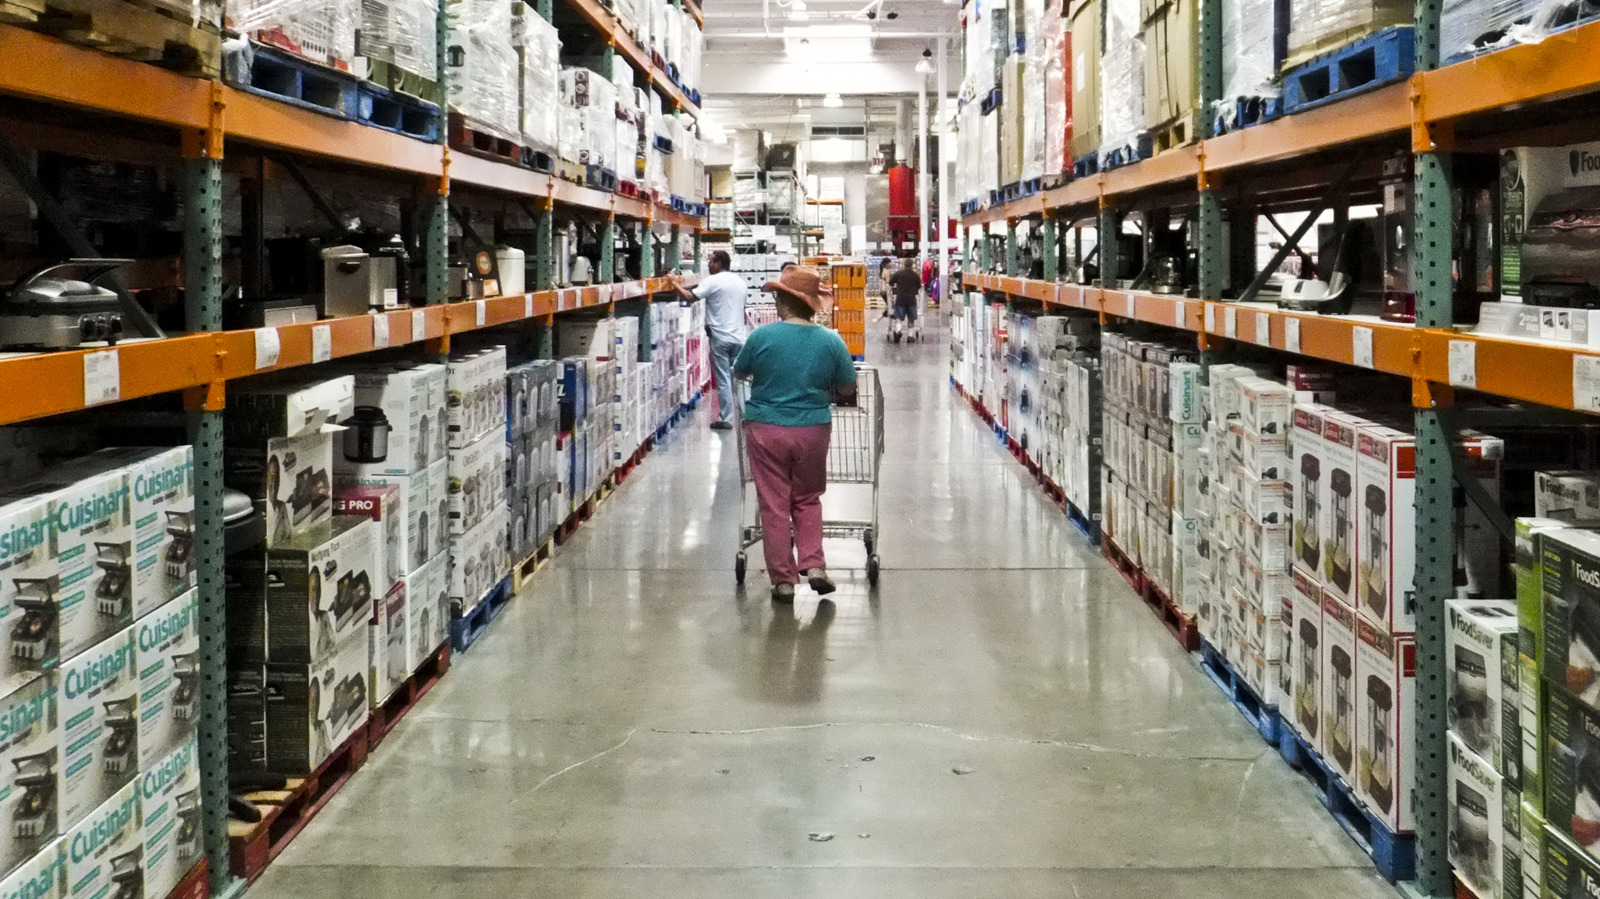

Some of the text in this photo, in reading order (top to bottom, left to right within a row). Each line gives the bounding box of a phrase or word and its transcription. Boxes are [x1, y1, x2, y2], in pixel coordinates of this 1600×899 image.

[1182, 370, 1191, 420] Cuisinart
[134, 461, 193, 502] Cuisinart
[57, 485, 130, 532] Cuisinart
[349, 501, 374, 510] PRO
[138, 598, 198, 653] Cuisinart
[1456, 612, 1493, 650] FoodSaver
[64, 636, 136, 700] Cuisinart
[1457, 748, 1495, 793] FoodSaver
[71, 785, 142, 864] Cuisinart
